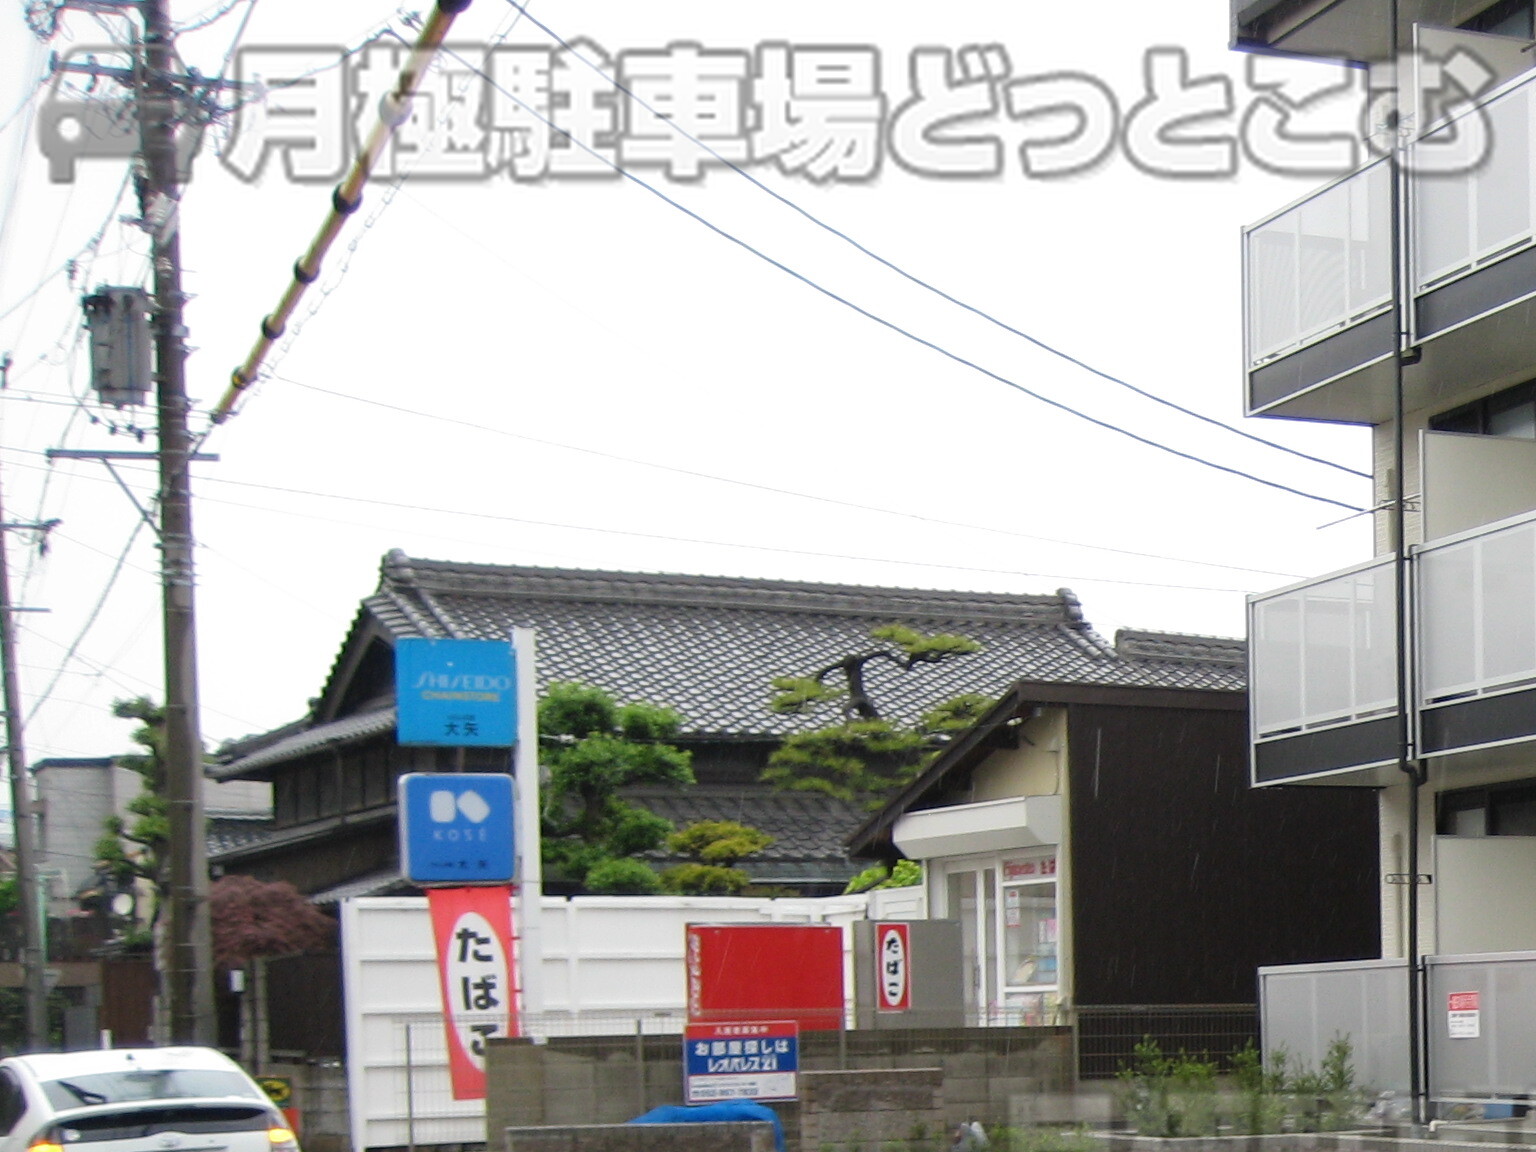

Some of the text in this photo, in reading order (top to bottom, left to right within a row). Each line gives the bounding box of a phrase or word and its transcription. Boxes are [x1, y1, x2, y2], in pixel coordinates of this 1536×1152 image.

[413, 671, 512, 690] SHISEIDO
[886, 937, 900, 996] たばこ
[694, 1039, 795, 1057] お部屋探しは
[708, 1055, 778, 1073] レオパレス21
